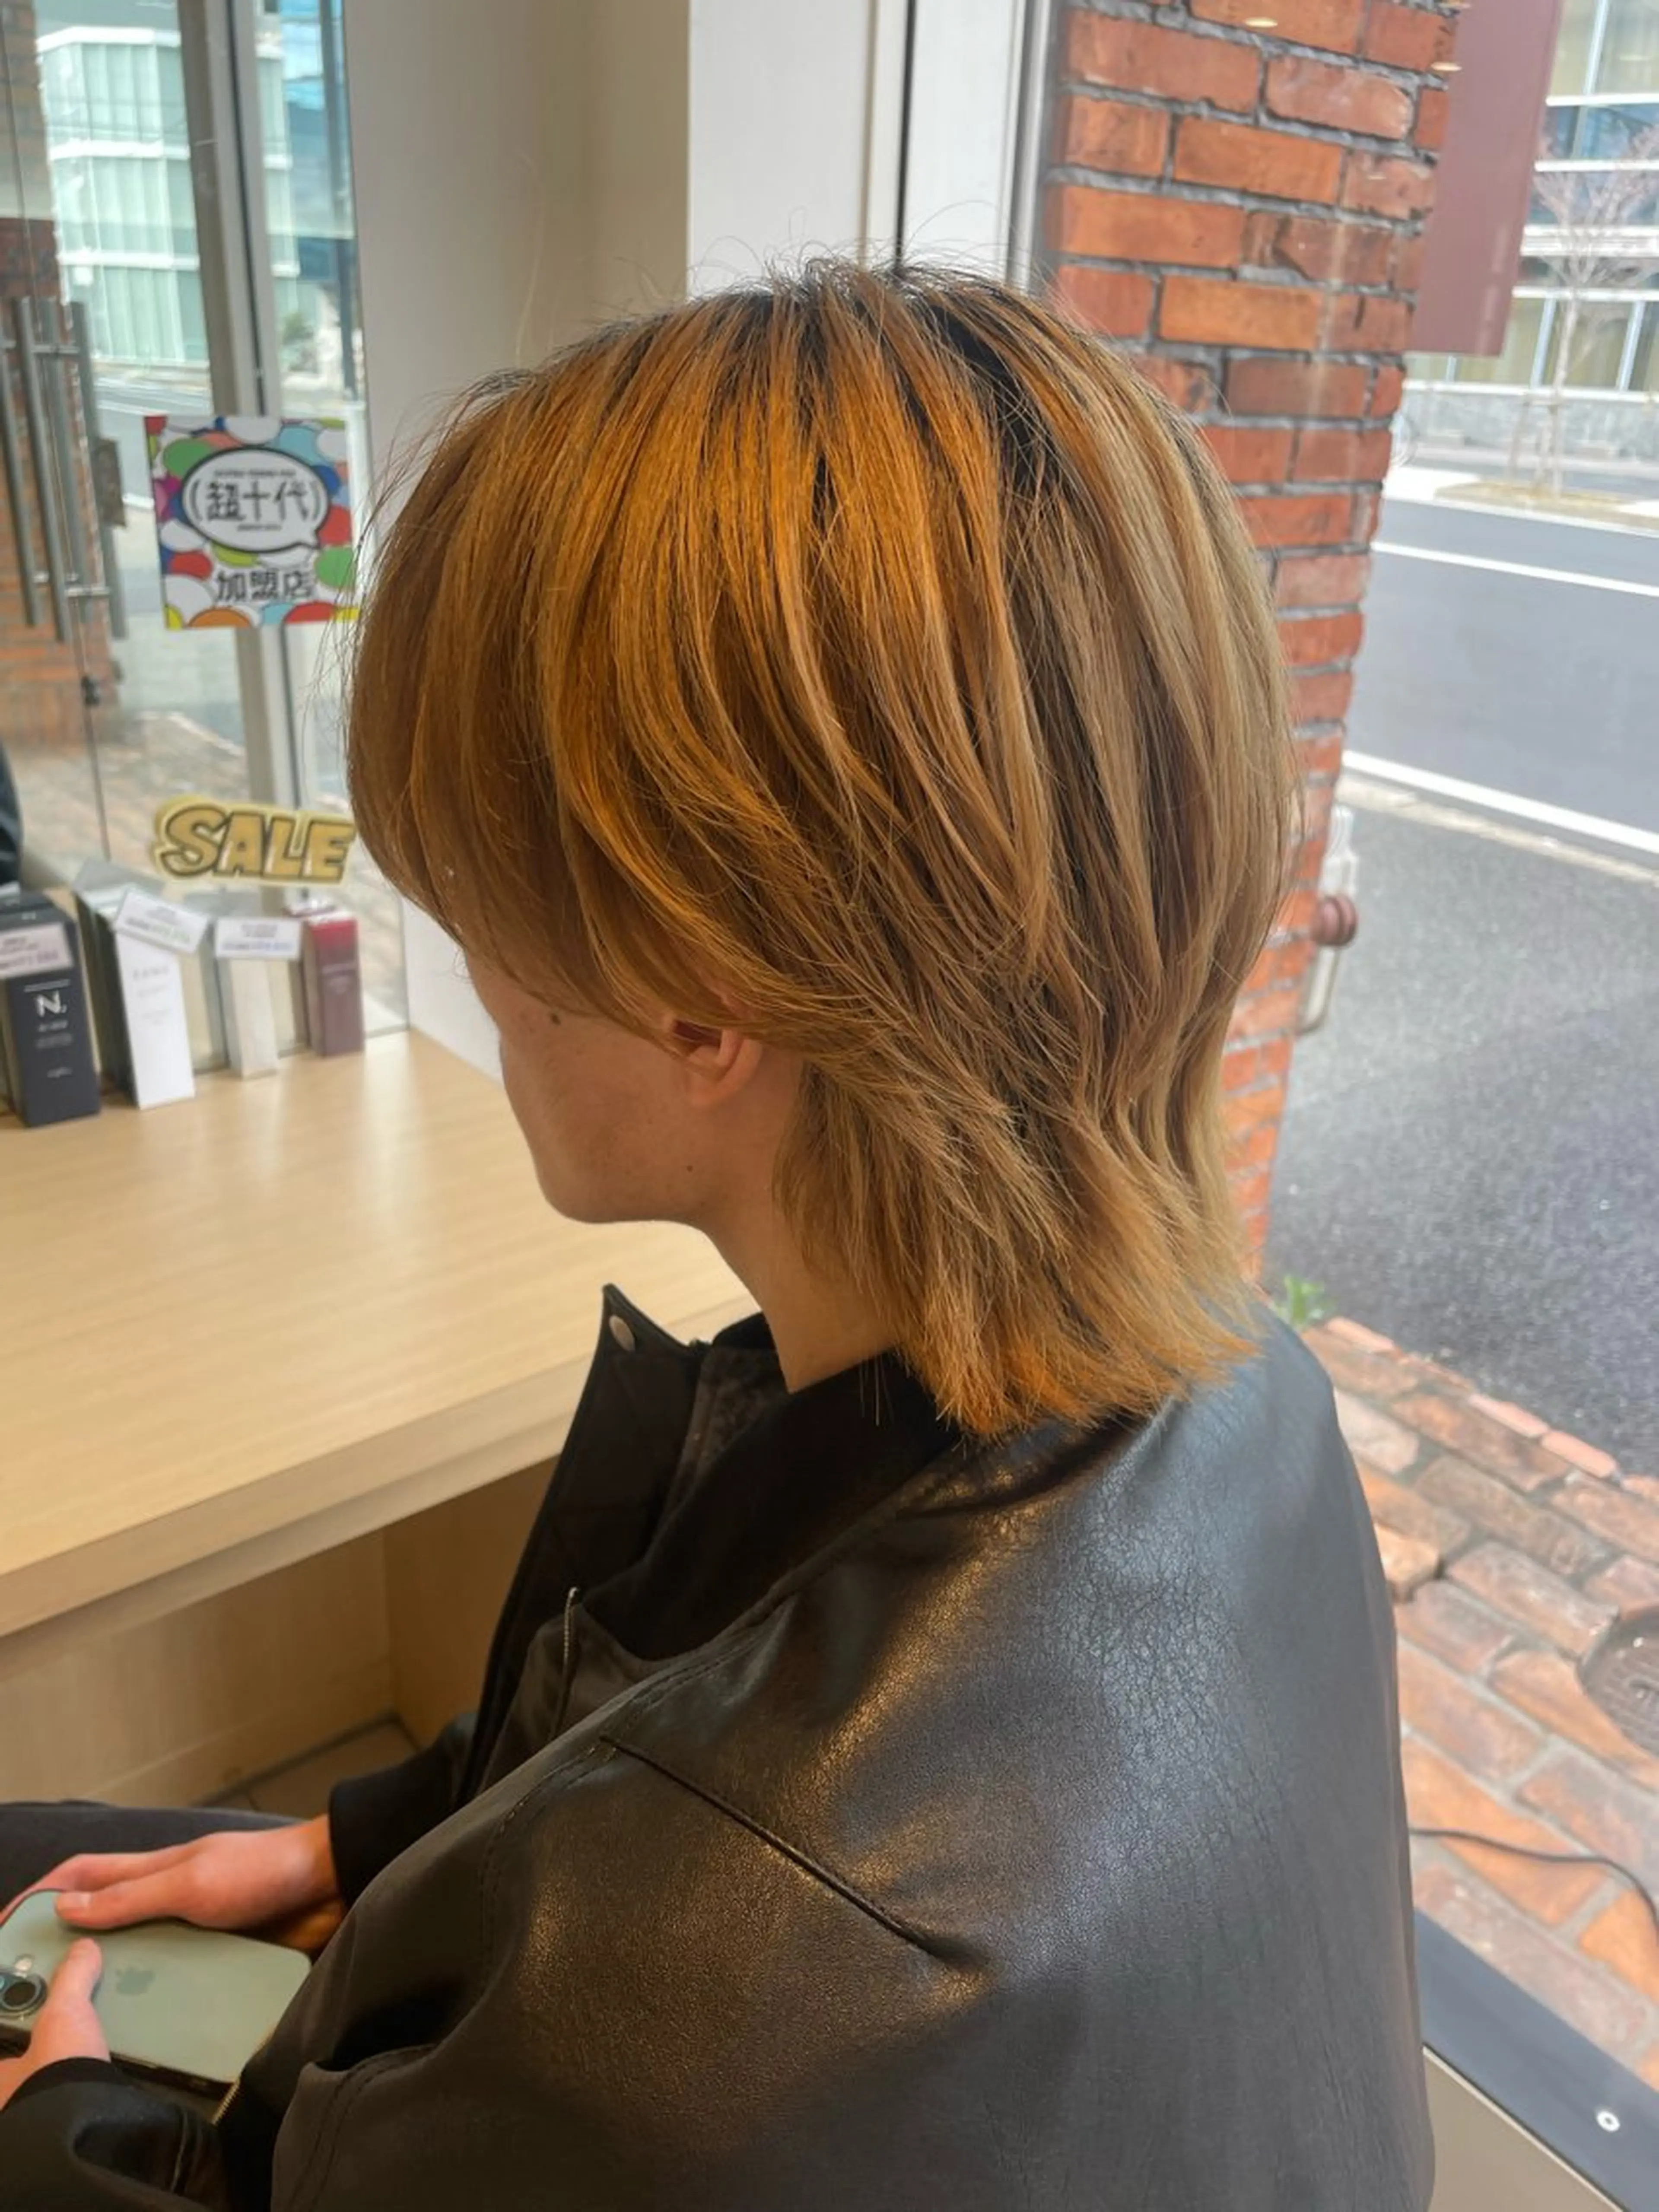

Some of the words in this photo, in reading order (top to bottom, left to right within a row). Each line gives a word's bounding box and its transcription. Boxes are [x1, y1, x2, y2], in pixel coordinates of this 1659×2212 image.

[216, 569, 313, 602] 加盟店
[160, 803, 356, 883] SALE
